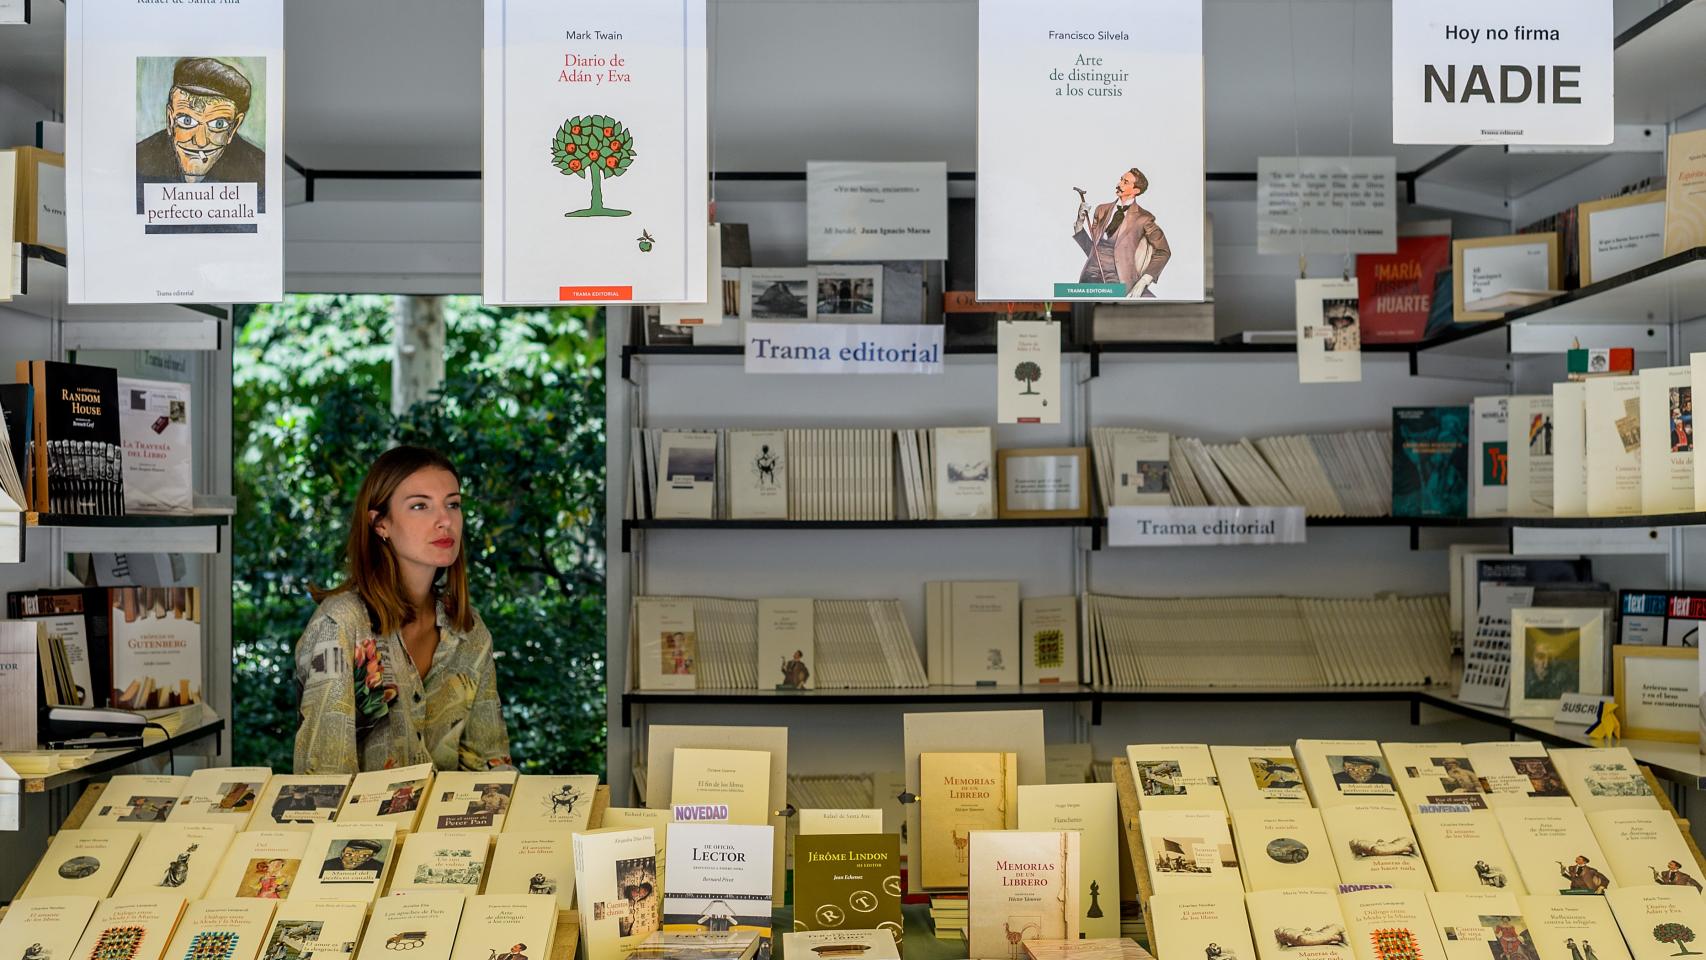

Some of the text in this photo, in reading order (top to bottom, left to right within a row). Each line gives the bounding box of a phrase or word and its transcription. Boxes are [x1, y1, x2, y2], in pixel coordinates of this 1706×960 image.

[566, 30, 622, 40] Mark Twain
[1048, 31, 1129, 41] Francisco Silvela
[1446, 25, 1560, 43] Hoy no firma
[564, 54, 625, 67] Diario de
[1075, 54, 1103, 66] Arte
[558, 70, 631, 86] Adán y Eva
[1050, 68, 1129, 85] de distinguir
[1055, 84, 1123, 96] a los cursis
[1424, 64, 1582, 104] NADIE
[162, 185, 240, 201] Manual del
[148, 204, 256, 224] perfecto canalla
[1376, 295, 1430, 314] HUARTE
[752, 336, 938, 364] Trama editorial
[62, 388, 101, 404] RANDOM
[72, 402, 102, 416] HOUSE
[1138, 519, 1276, 536] Trama editorial
[128, 639, 187, 648] GUTENBERG
[944, 776, 996, 786] MEMORIAS
[950, 790, 990, 798] LIBRERO
[676, 806, 728, 820] NOVEDAD
[692, 848, 746, 862] LECTOR
[808, 851, 888, 862] JÉRÔME LINDON
[996, 860, 1055, 871] MEMORIAS
[1003, 876, 1048, 887] LIBRERO
